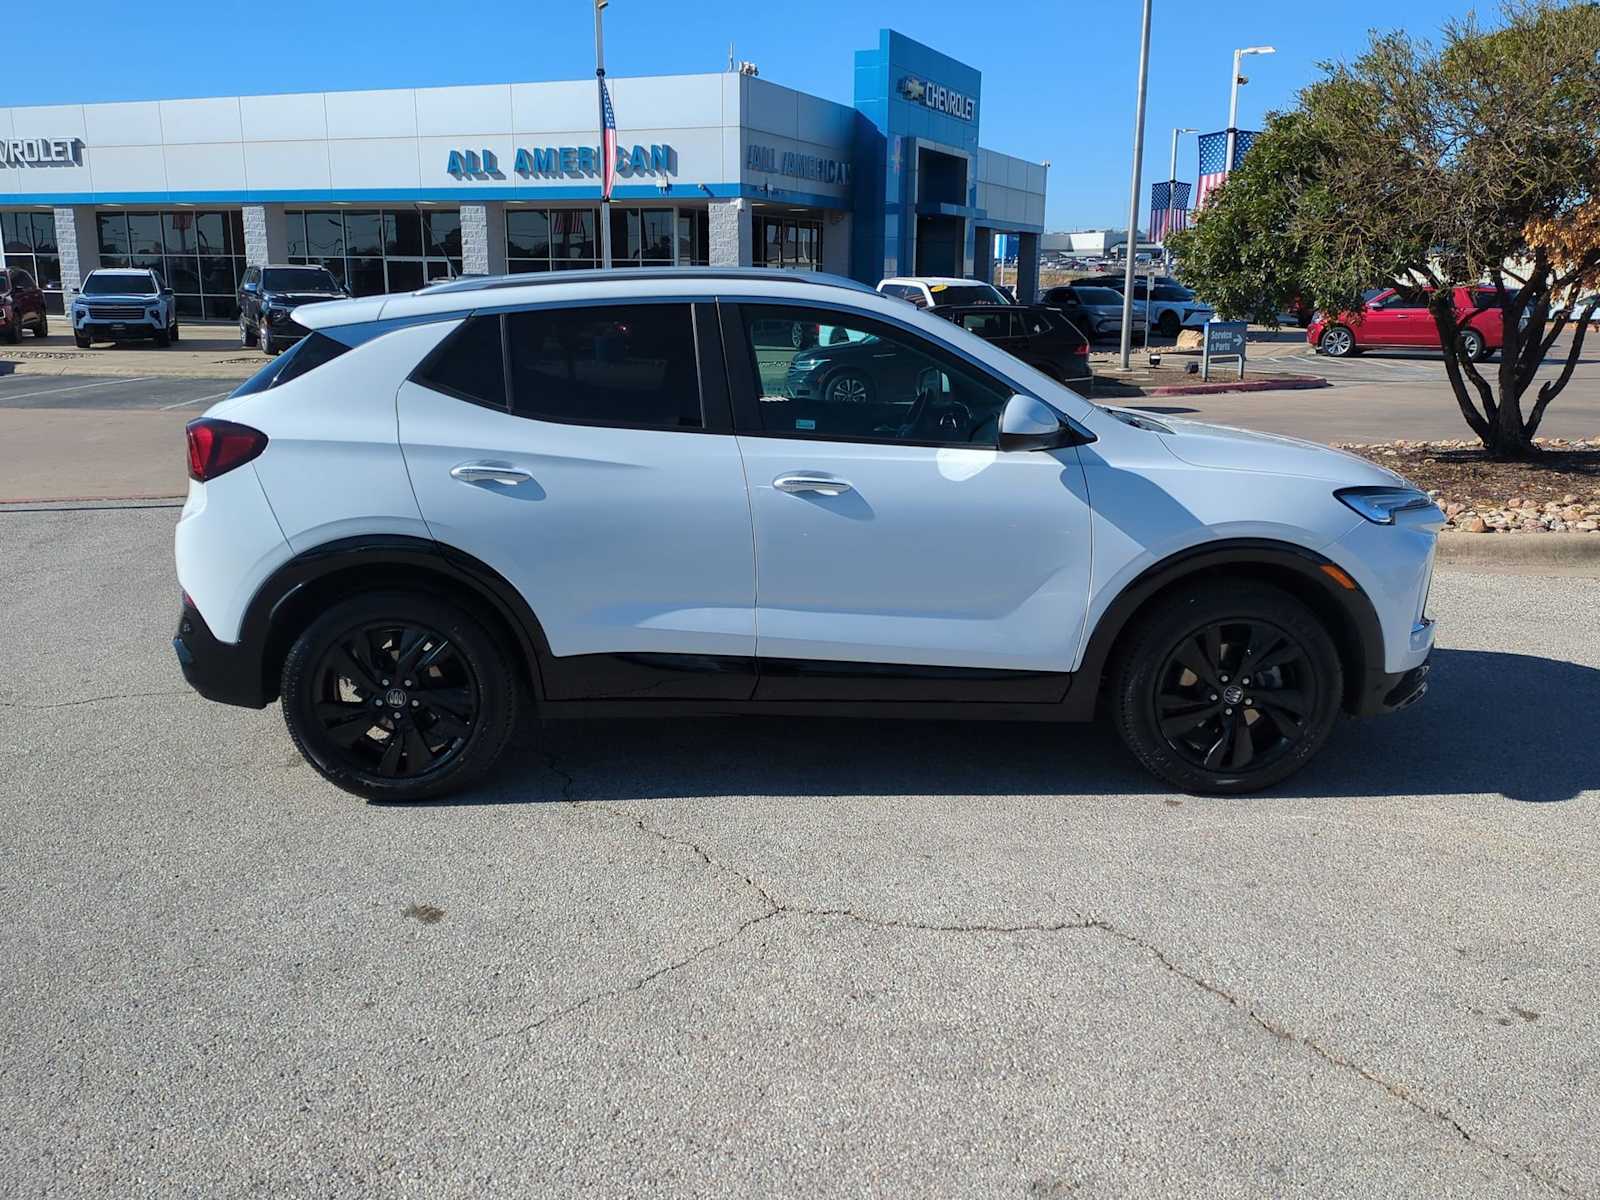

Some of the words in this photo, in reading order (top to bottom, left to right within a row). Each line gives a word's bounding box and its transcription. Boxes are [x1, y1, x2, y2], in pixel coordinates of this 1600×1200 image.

[925, 81, 976, 121] CHEVROLET
[447, 149, 501, 176] ALL
[1210, 330, 1233, 340] Service
[1215, 342, 1231, 351] Parts
